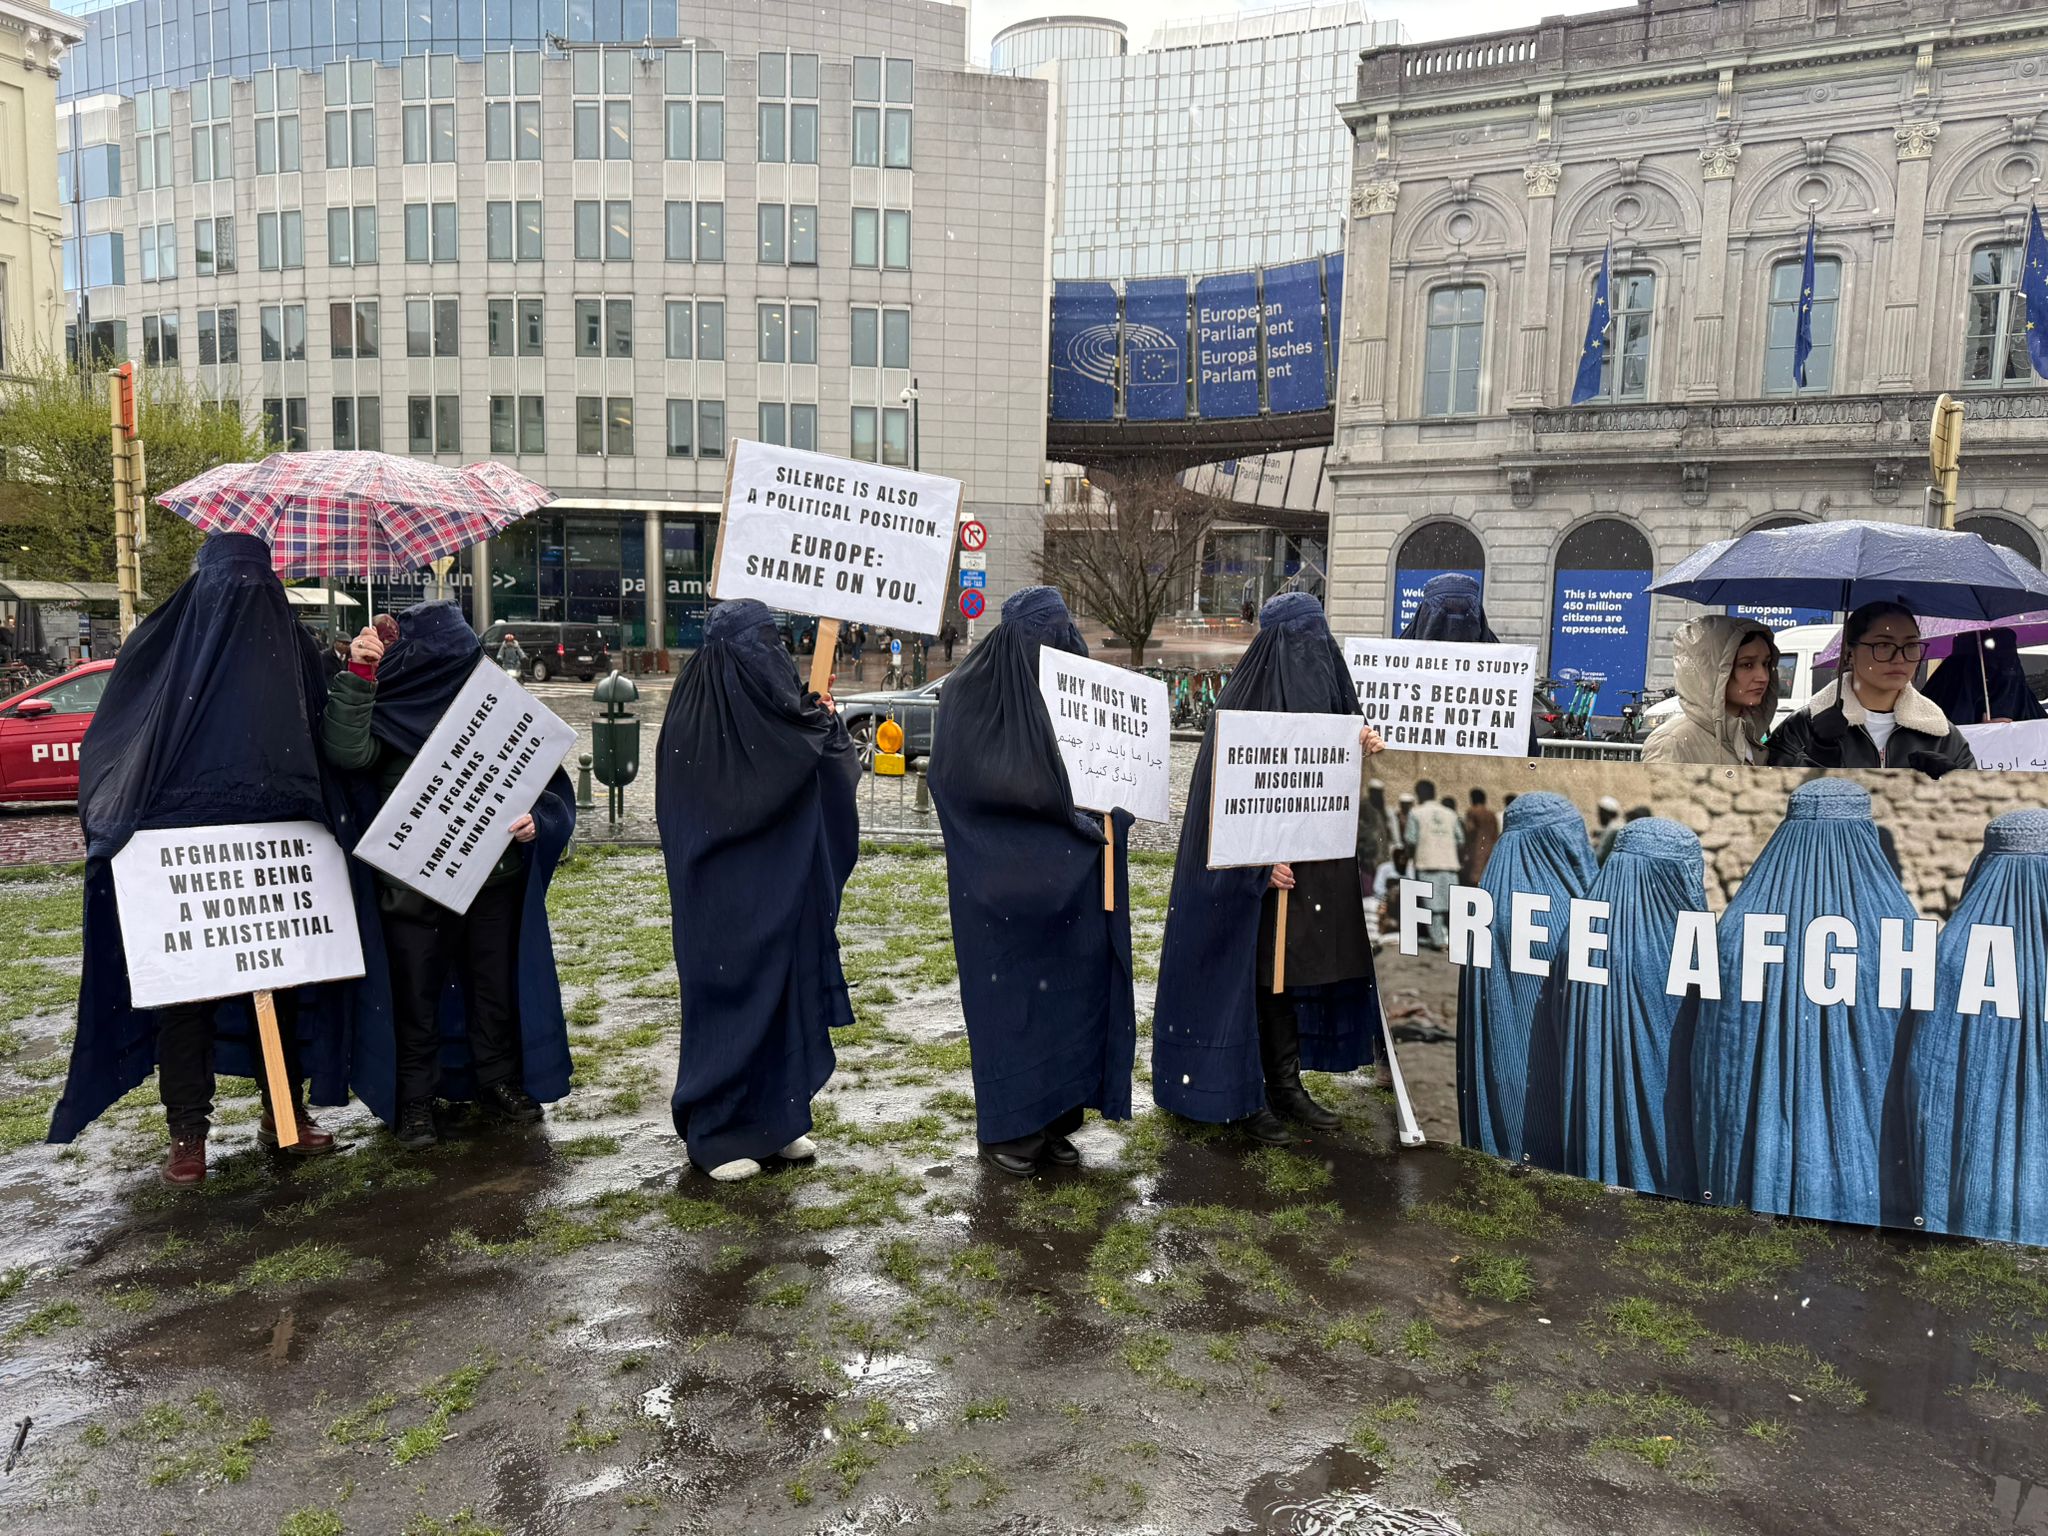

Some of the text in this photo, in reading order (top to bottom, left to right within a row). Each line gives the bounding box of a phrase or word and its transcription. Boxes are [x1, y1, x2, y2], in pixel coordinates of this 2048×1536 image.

[1200, 303, 1282, 324] European
[1201, 318, 1294, 342] Parliament
[1202, 340, 1313, 366] Europäisches
[1202, 362, 1293, 384] Parlament
[776, 466, 919, 507] SILENCE IS ALSO
[1240, 466, 1284, 485] Parliament
[747, 488, 942, 538] A POLITICAL POSITION.
[790, 533, 883, 568] EUROPE:
[745, 554, 923, 606] SHAME ON YOU.
[1562, 602, 1622, 611] 450 million
[1564, 589, 1633, 600] This is where
[1562, 612, 1622, 622] citizens are
[1737, 605, 1792, 615] European
[1562, 625, 1629, 635] represented.
[1354, 654, 1529, 675] ARE YOU ABLE TO STUDY?
[1056, 672, 1148, 716] WHY MUST WE
[1431, 684, 1518, 707] BECAUSE
[1060, 698, 1149, 739] LIVE IN HELL?
[1399, 704, 1435, 724] ARE
[1444, 708, 1482, 726] NOT
[1490, 710, 1516, 729] AN
[1373, 724, 1499, 750] AFGHAN GIRL
[1057, 733, 1163, 771] چرا ما باید در جهنم
[388, 822, 414, 851] LAS
[441, 761, 453, 772] Y
[450, 693, 498, 759] MUJERES
[438, 750, 485, 815] AFGANAS
[1112, 767, 1138, 786] زندگی
[1254, 771, 1324, 790] MISOGINIA
[419, 712, 534, 879] TAMBIÉN HEMOS VENIDO
[445, 735, 545, 879] AL MUNDO A VIVIRLO.
[1225, 796, 1350, 815] INSTITUCIONALIZADA
[160, 838, 313, 868] AFGHANISTAN:
[169, 864, 313, 895] WHERE BEING
[180, 890, 313, 922] A WOMAN IS
[164, 915, 334, 953] AN EXISTENTIAL
[235, 948, 285, 972] RISK
[1399, 877, 2048, 1022] FREE AFGHA
